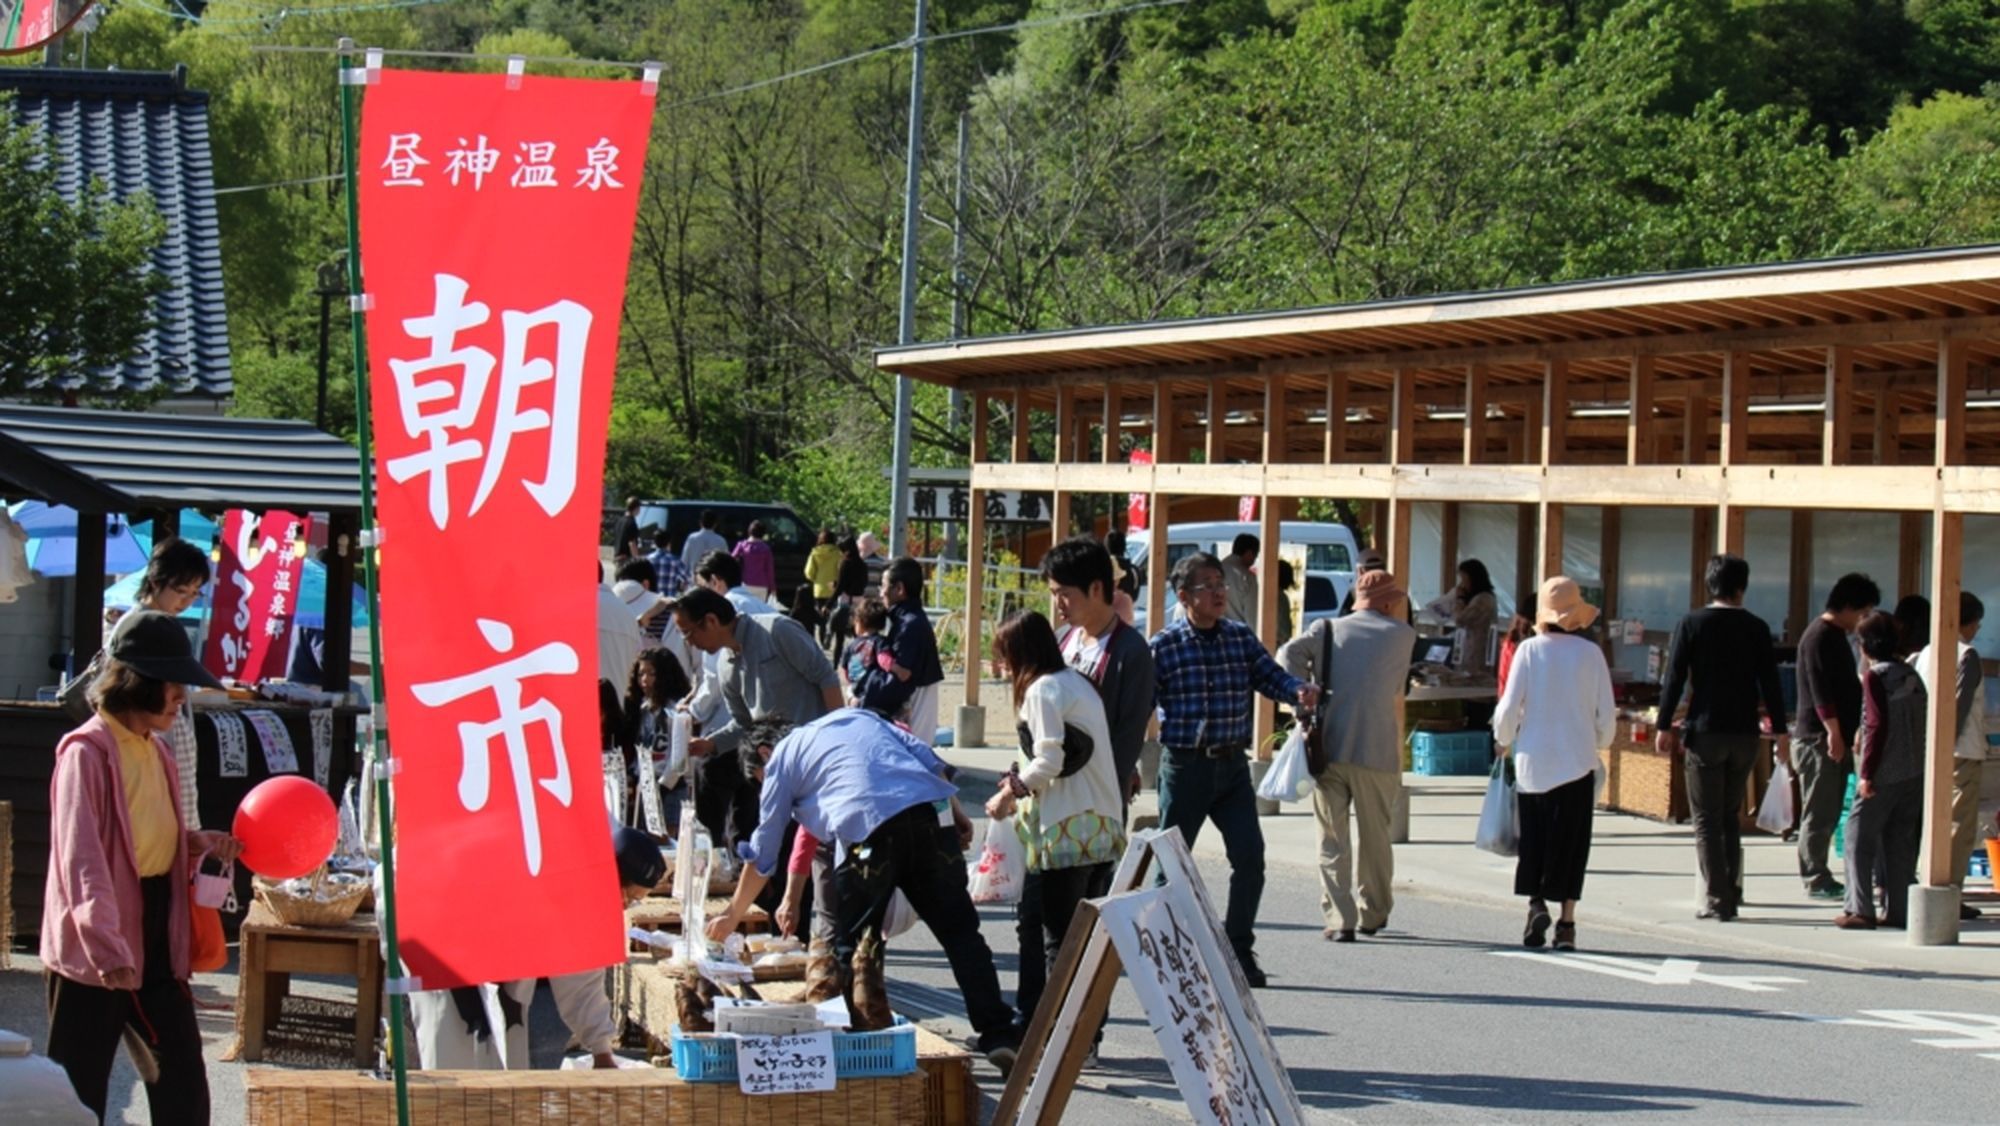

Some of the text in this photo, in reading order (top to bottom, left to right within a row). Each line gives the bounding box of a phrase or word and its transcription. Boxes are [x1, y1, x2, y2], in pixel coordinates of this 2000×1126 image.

[381, 132, 624, 191] 昼神温泉
[386, 273, 594, 877] 朝市
